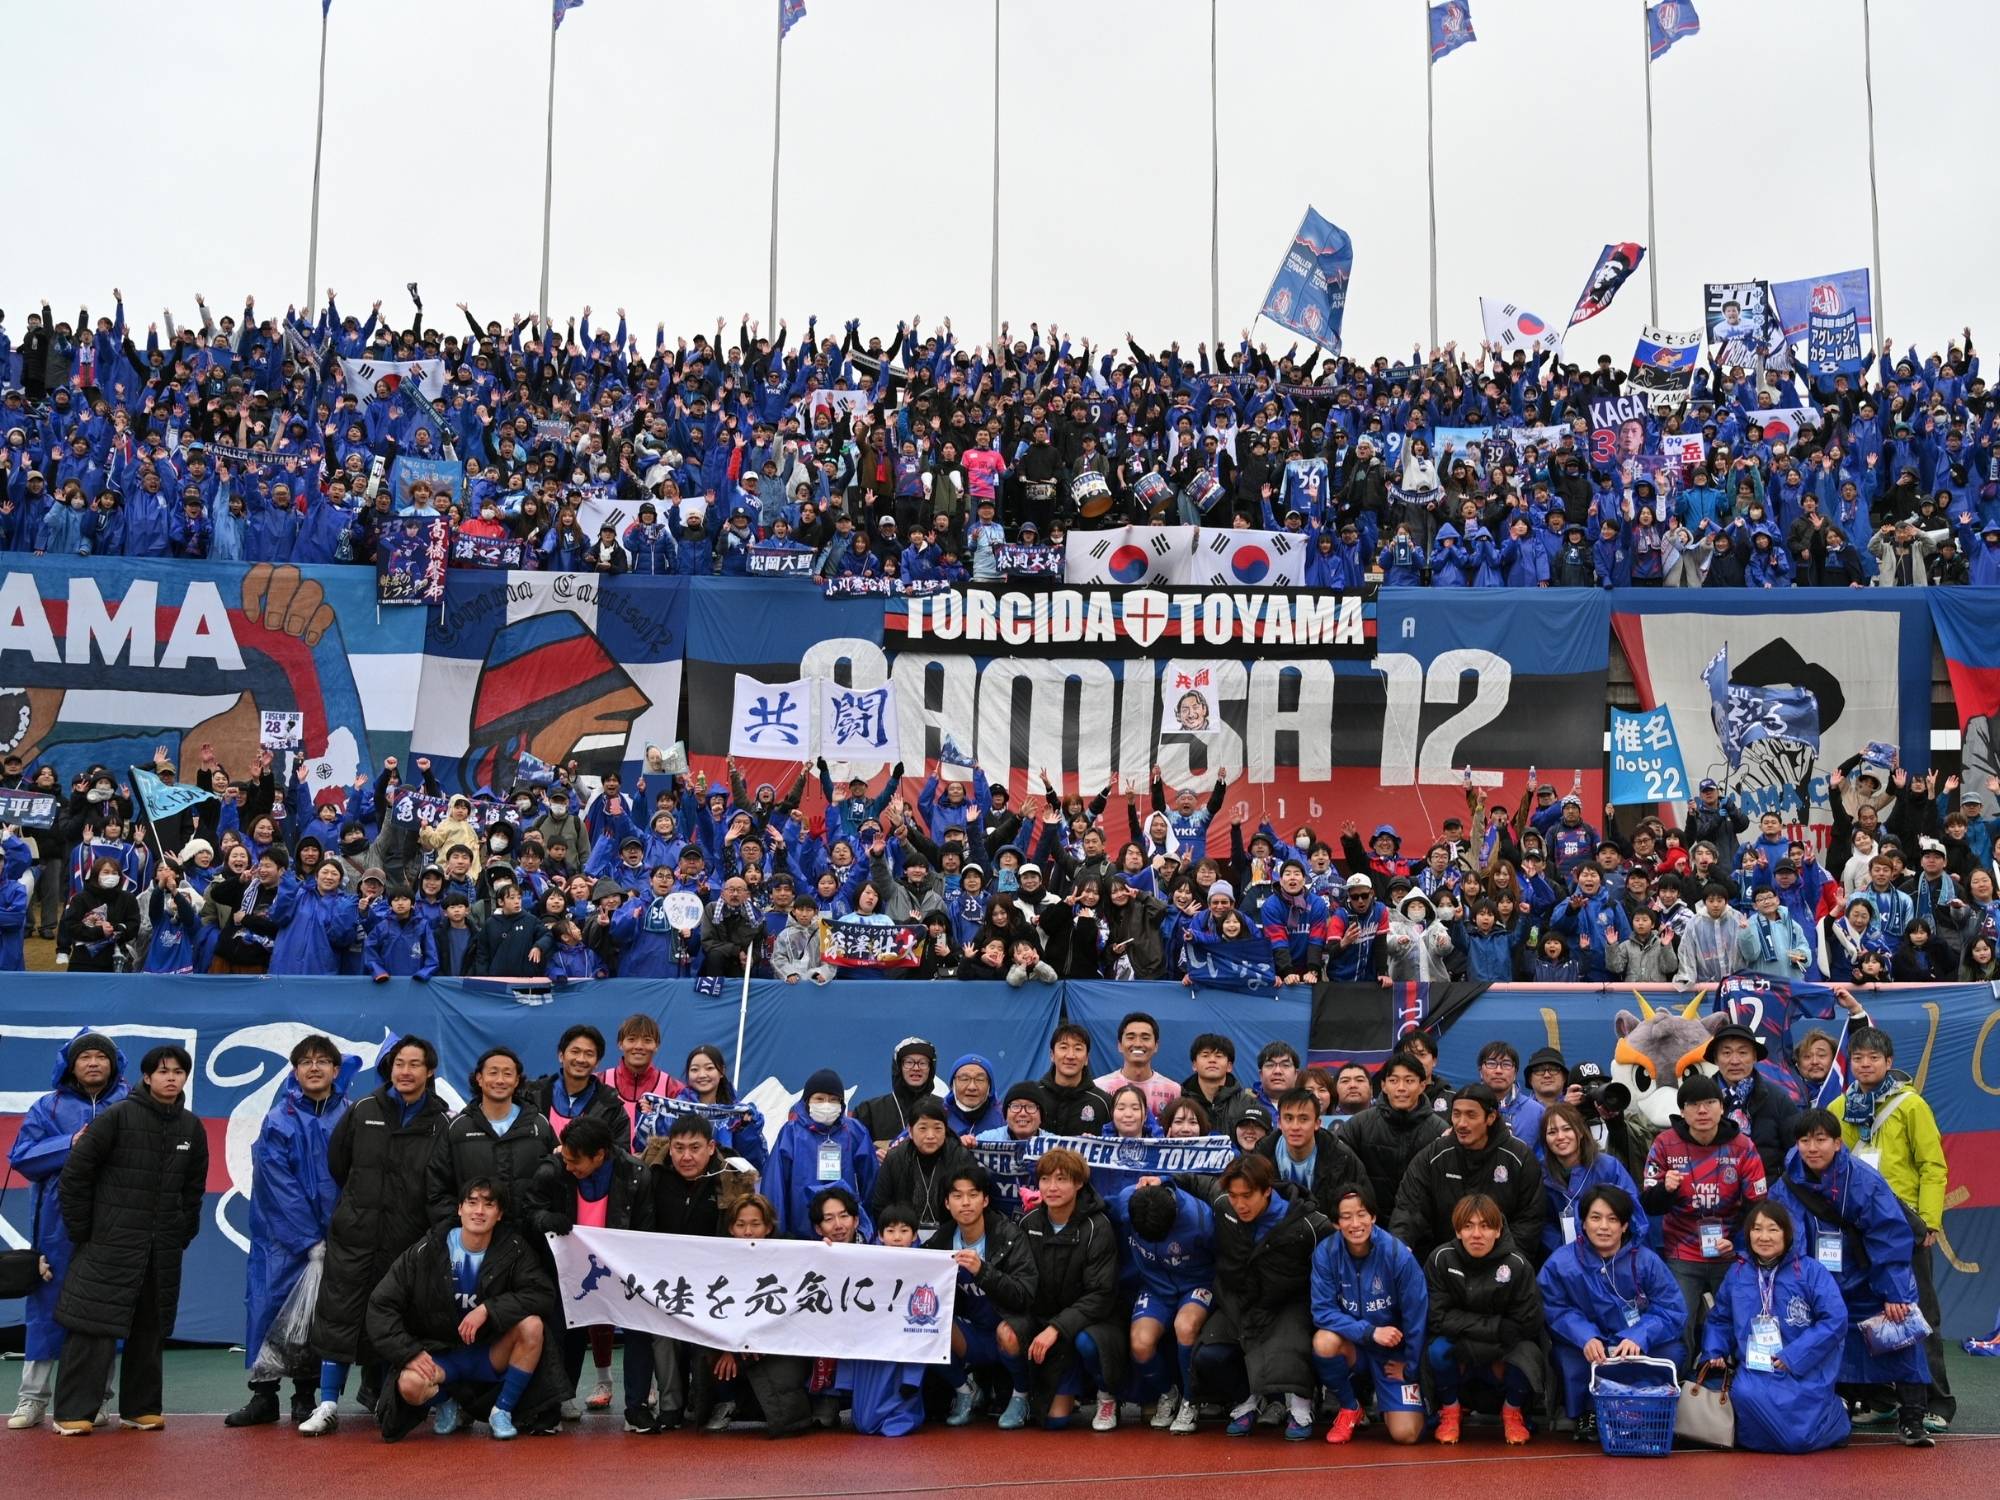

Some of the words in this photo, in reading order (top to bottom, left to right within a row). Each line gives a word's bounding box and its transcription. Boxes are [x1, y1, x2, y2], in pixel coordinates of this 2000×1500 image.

[1642, 326, 1685, 345] Let's
[1091, 405, 1101, 423] 9
[1588, 396, 1647, 429] KAGA
[1591, 429, 1617, 463] 3
[1666, 437, 1683, 447] 99
[1487, 446, 1503, 463] 39
[1681, 442, 1705, 463] 岳
[564, 530, 574, 542] 16
[750, 553, 813, 571] 松岡大智
[906, 588, 1116, 646] TORCIDA
[1167, 591, 1366, 646] TOYAMA
[1371, 648, 1512, 787] 12
[265, 721, 281, 733] 28
[1614, 715, 1673, 753] 椎名
[1643, 767, 1683, 800] 22
[1173, 827, 1198, 837] YKK
[651, 907, 664, 919] 56
[965, 899, 977, 912] 33
